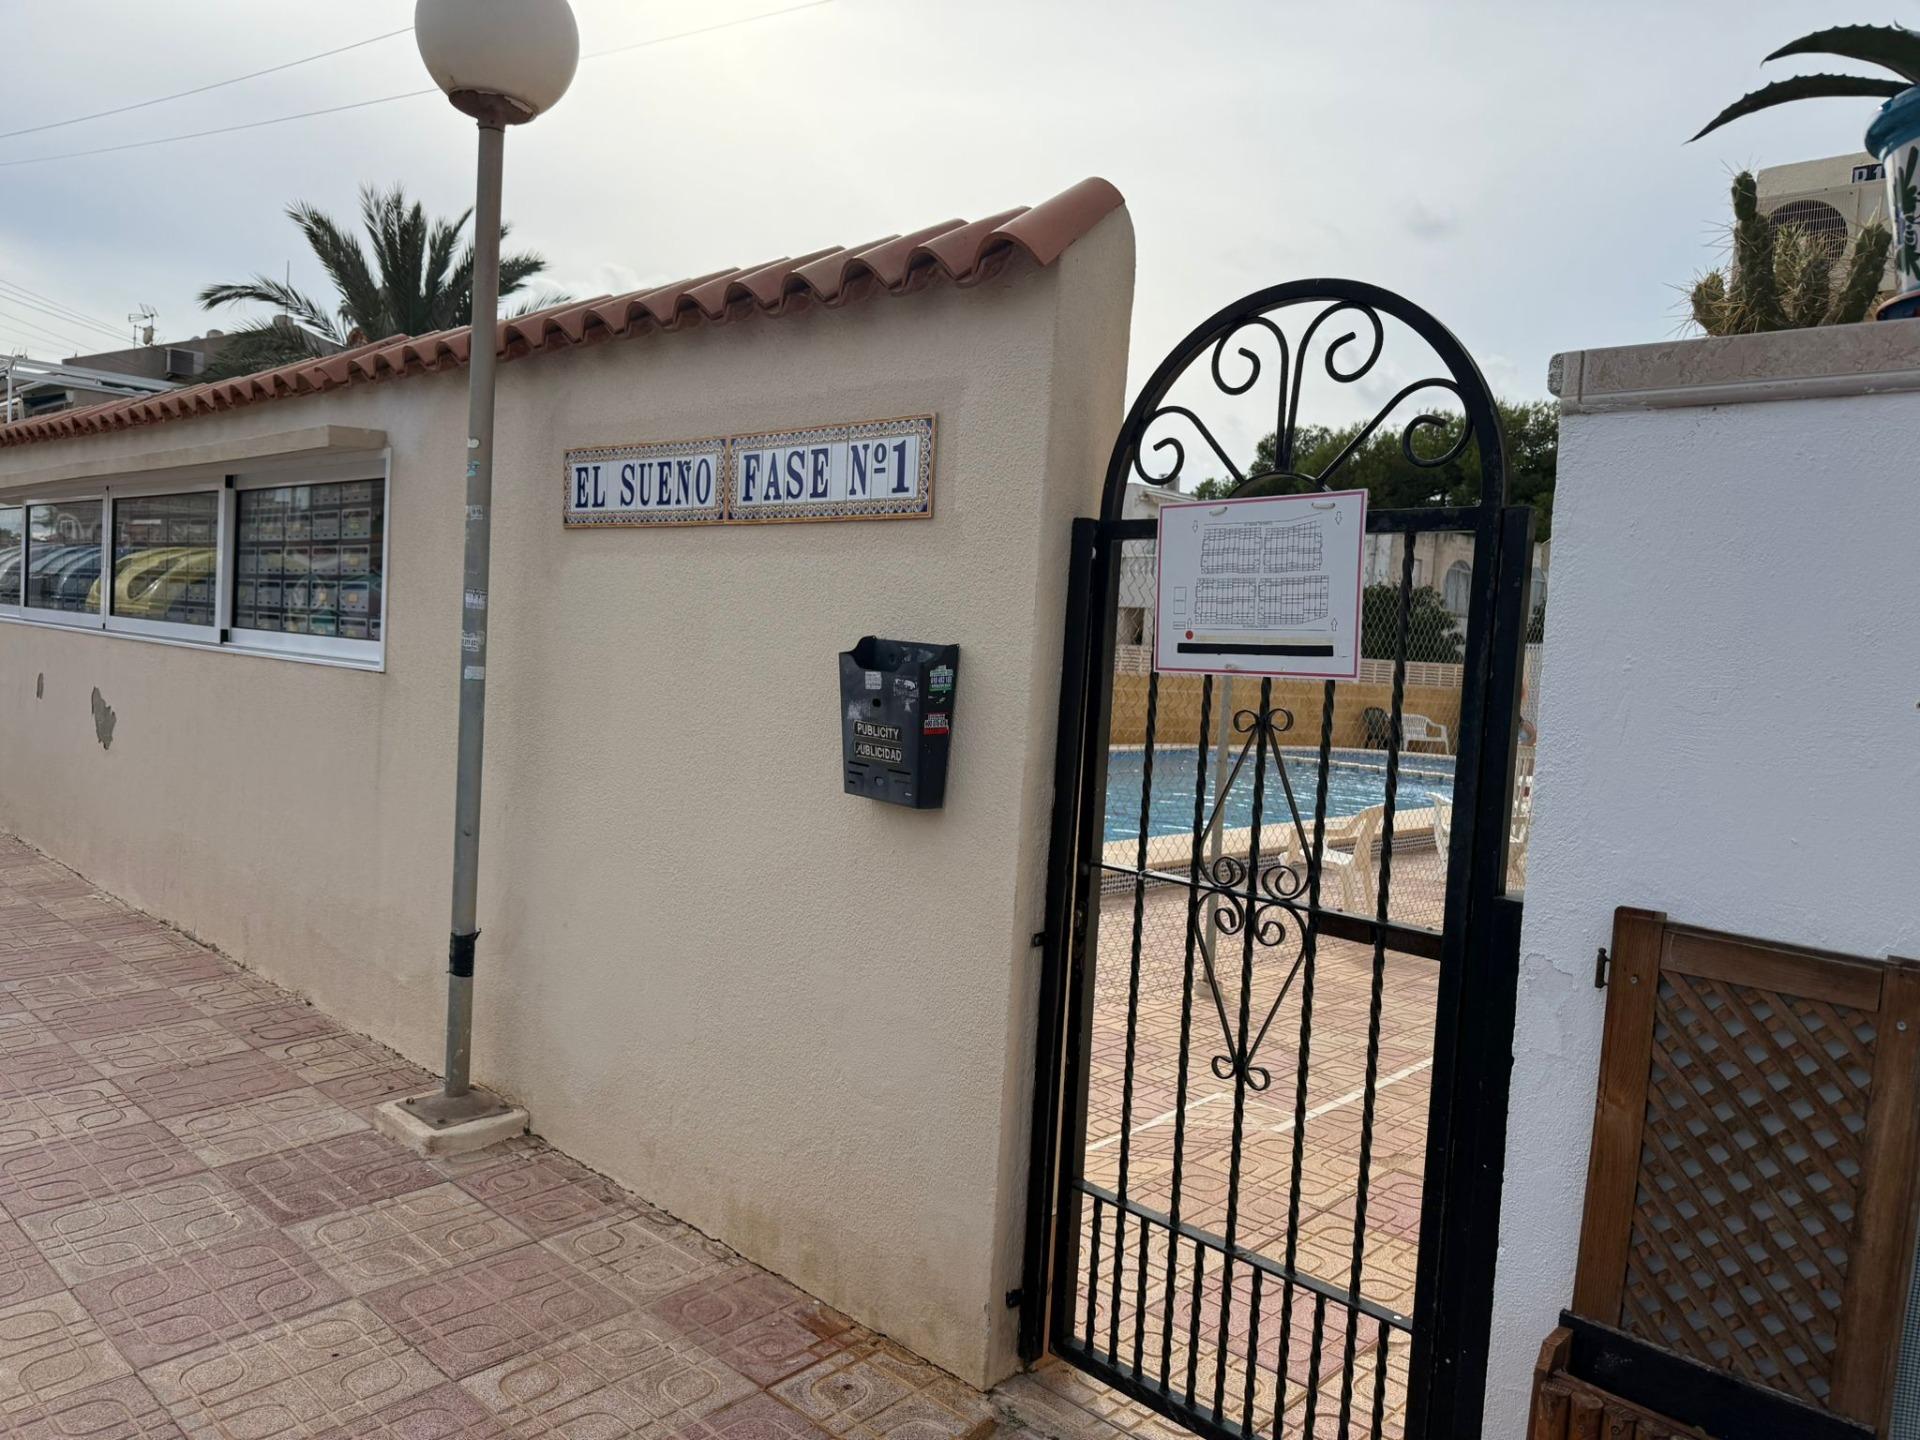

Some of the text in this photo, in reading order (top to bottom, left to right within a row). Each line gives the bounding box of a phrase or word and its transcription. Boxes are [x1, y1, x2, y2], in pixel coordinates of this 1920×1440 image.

[575, 438, 911, 508] EL SUEÑO FASE Nº1
[857, 722, 899, 740] PUBLICITY
